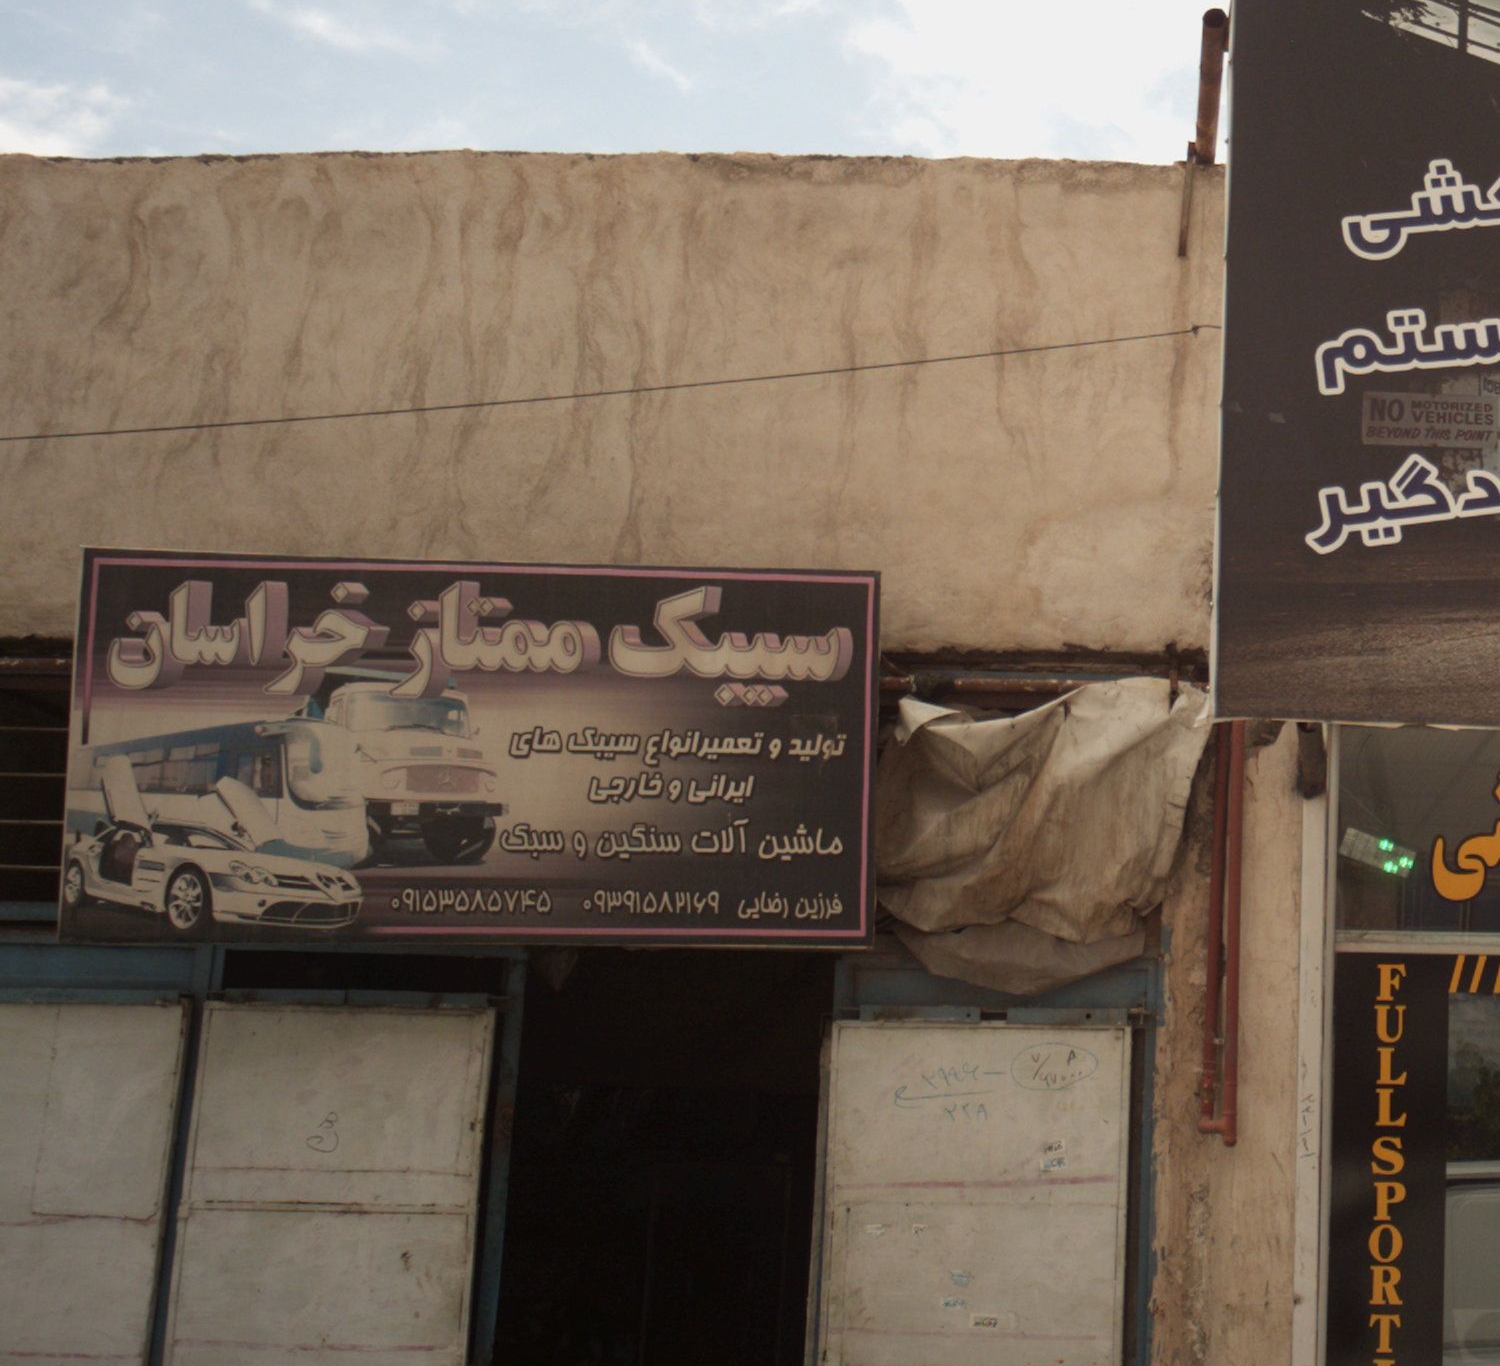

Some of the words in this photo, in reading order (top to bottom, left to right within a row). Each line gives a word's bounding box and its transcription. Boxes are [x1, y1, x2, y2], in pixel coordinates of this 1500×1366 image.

[1369, 398, 1405, 422] NO
[1411, 400, 1493, 412] MOTORIZED
[1412, 411, 1494, 425] VEHICLES
[1367, 426, 1421, 439] BEYOND
[1423, 427, 1450, 440] THIS
[1455, 430, 1493, 442] POINT
[107, 580, 390, 694] خراسان
[389, 580, 599, 698] ممتاز
[609, 586, 854, 707] سیبک
[508, 727, 562, 757] های
[567, 727, 640, 760] سیبک
[768, 738, 781, 759] و
[788, 733, 847, 762] تولید
[587, 772, 663, 802] خارجی
[667, 779, 681, 801] و
[686, 774, 754, 804] ایرانی
[500, 823, 564, 858] سبک
[572, 831, 588, 858] و
[596, 824, 682, 858] سنگین
[690, 818, 749, 854] آلات
[758, 823, 843, 861] ماشین
[737, 890, 788, 919] رضایی
[795, 893, 843, 919] فرزین
